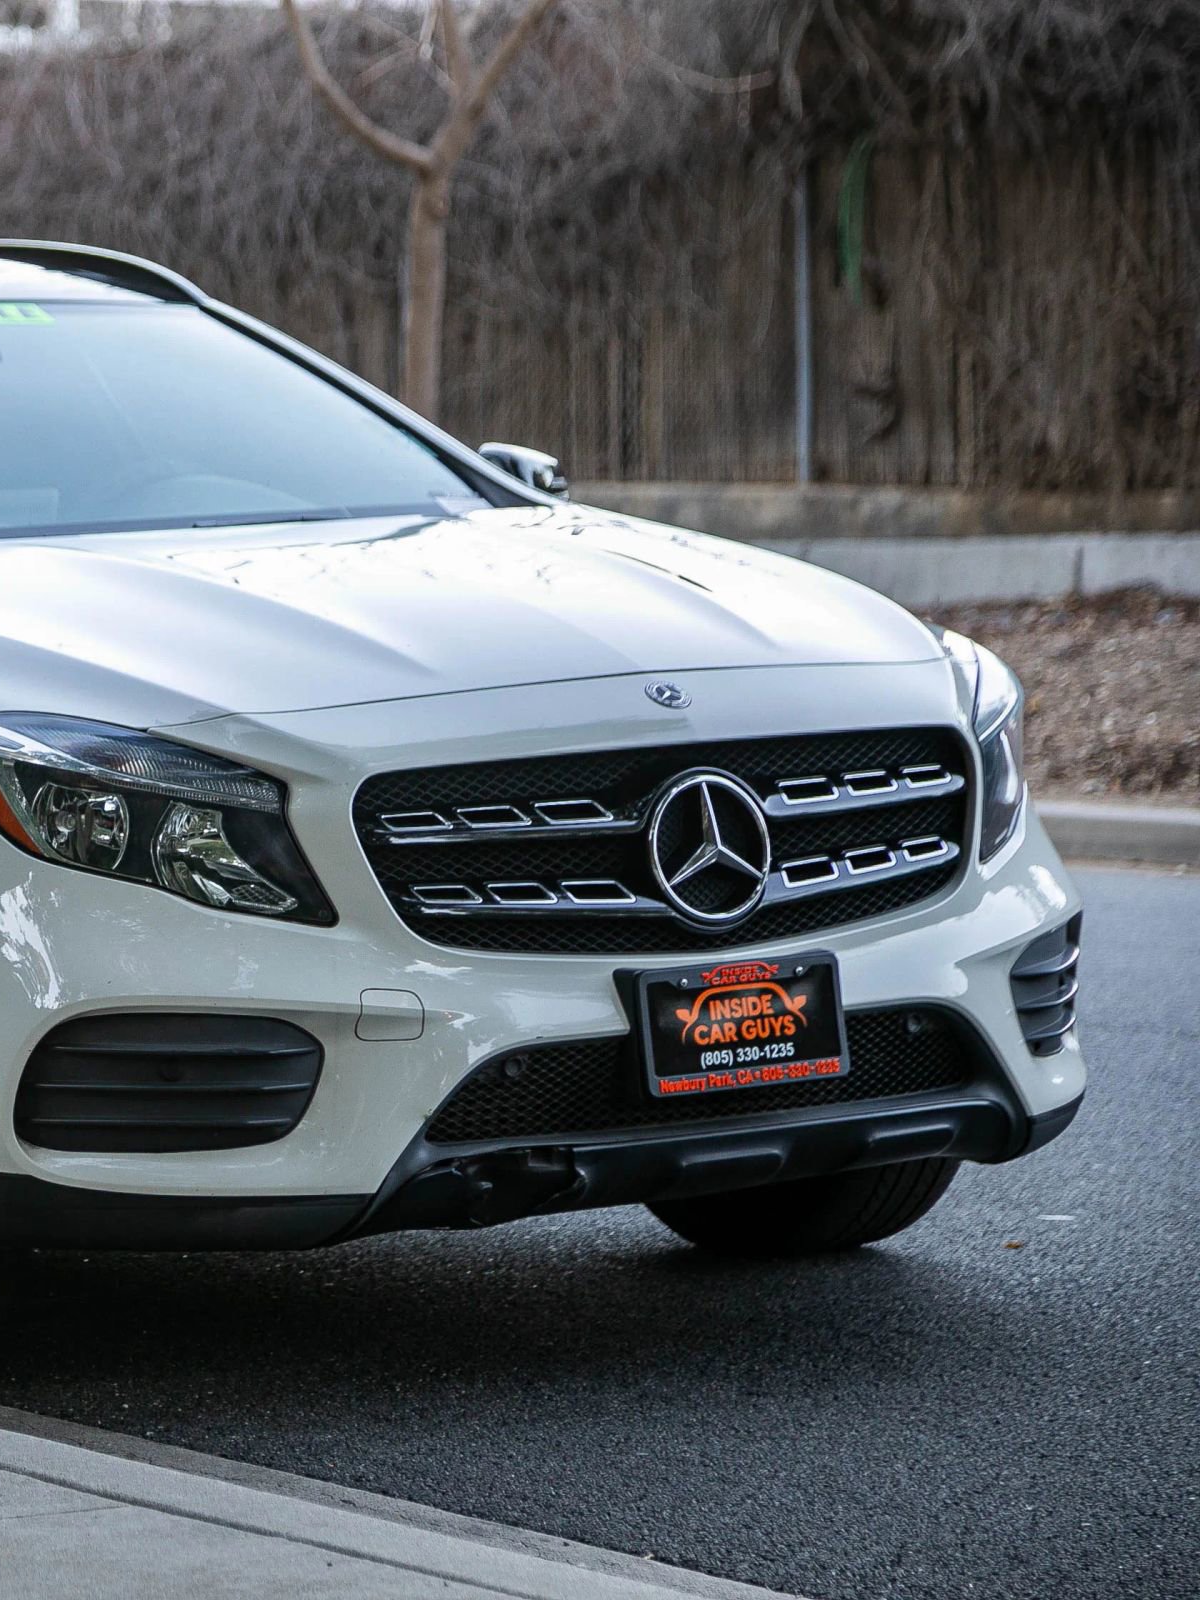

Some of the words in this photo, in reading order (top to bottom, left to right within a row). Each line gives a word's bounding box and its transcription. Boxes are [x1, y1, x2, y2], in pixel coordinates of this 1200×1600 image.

[711, 975, 736, 985] CAR
[739, 971, 771, 981] GUYS
[721, 966, 758, 976] INSIDE
[709, 994, 775, 1021] INSIDE
[693, 1022, 739, 1045] CAR
[741, 1015, 796, 1040] GUYS
[700, 1049, 734, 1070] (805)
[736, 1042, 795, 1062] 330-1235
[659, 1076, 706, 1095] Newbury
[708, 1073, 736, 1088] Park,
[737, 1070, 753, 1084] CA
